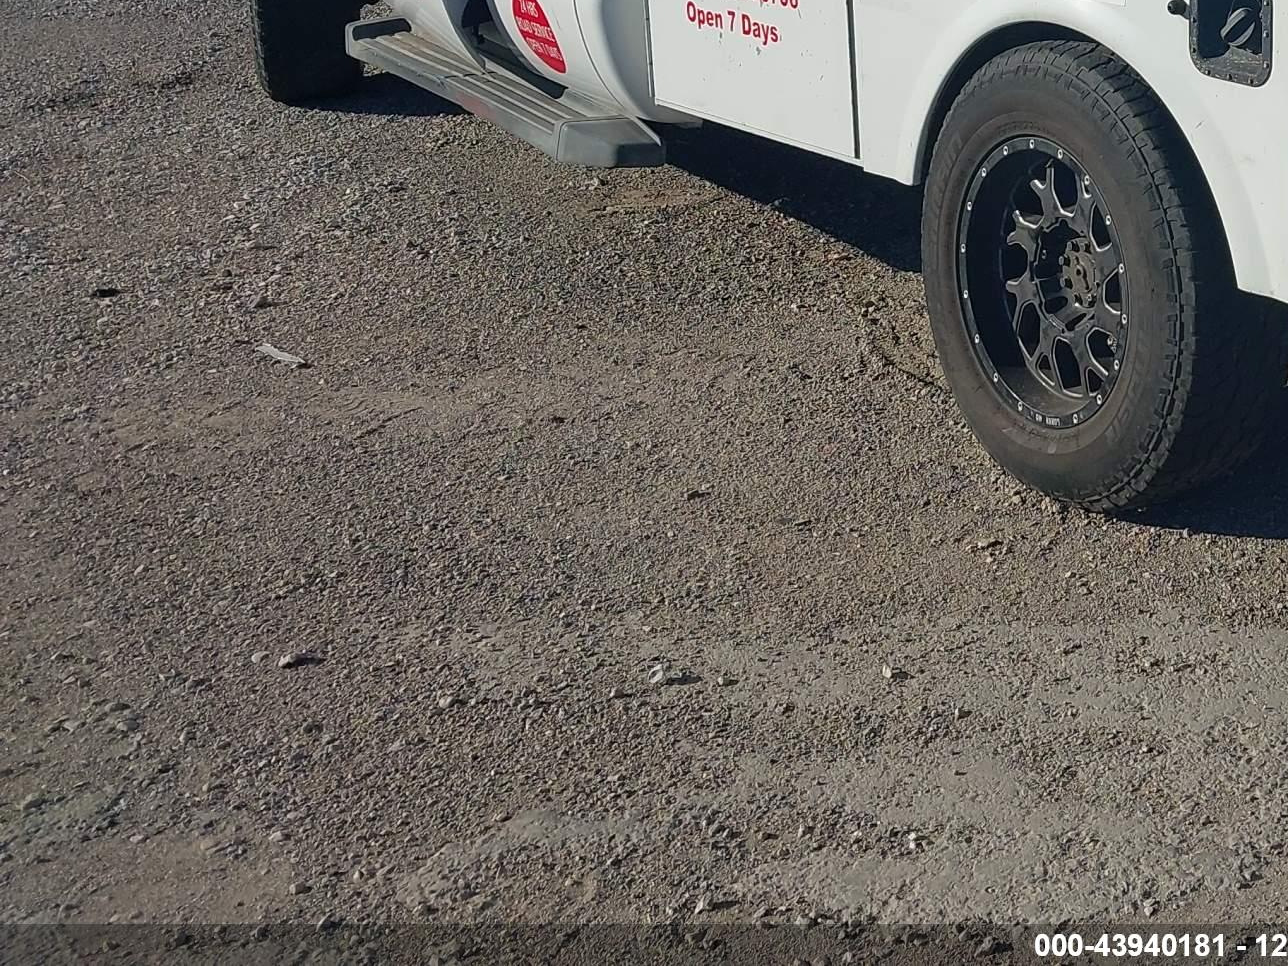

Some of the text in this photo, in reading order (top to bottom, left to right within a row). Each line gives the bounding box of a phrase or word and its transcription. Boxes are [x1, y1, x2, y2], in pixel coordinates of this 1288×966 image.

[686, 1, 779, 46] Open 7 Days
